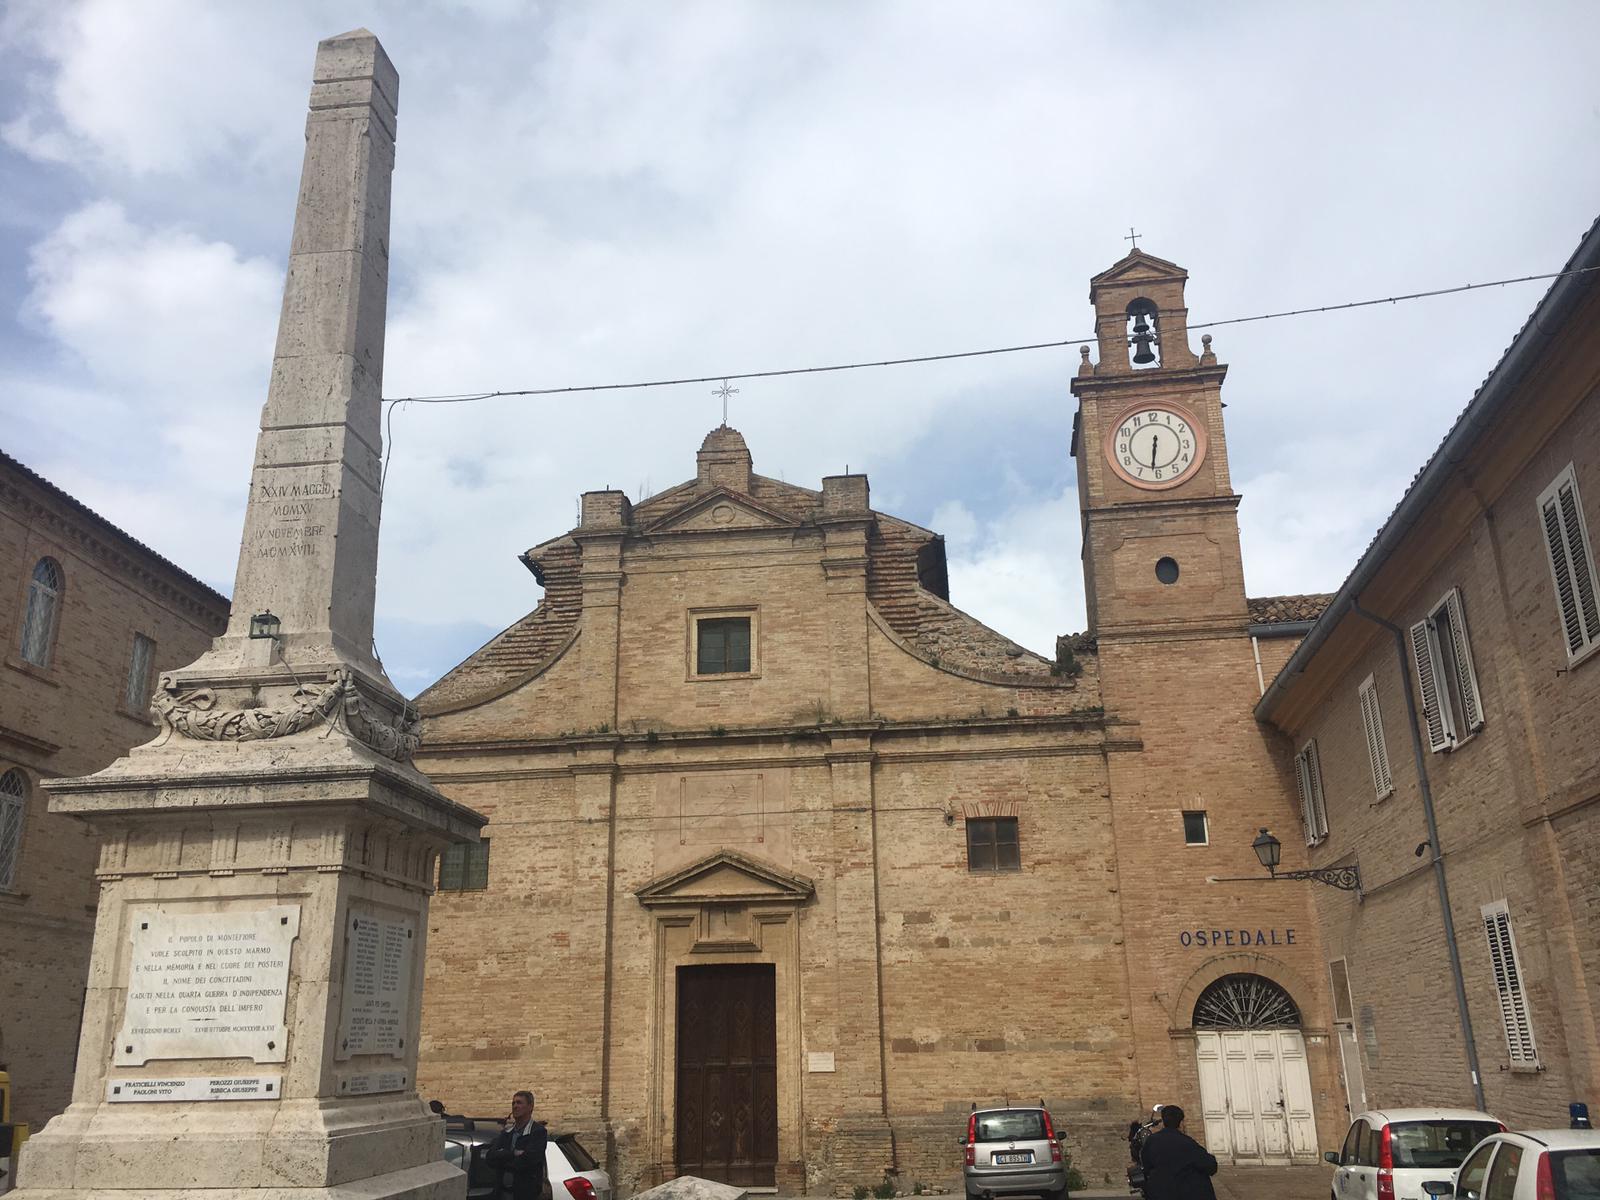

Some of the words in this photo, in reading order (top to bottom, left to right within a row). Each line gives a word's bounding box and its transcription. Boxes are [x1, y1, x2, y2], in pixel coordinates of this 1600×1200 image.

[1133, 416, 1141, 427] 11
[1148, 412, 1158, 422] 12
[1166, 415, 1171, 425] 1
[1120, 427, 1131, 437] 10
[1178, 423, 1185, 433] 2
[1120, 443, 1127, 453] 9
[1182, 439, 1190, 449] 3
[1124, 456, 1131, 466] 8
[1181, 453, 1188, 463] 4
[1136, 467, 1143, 477] 7
[1172, 464, 1179, 474] 5
[1155, 469, 1162, 480] 6
[261, 486, 289, 498] XXIV
[290, 482, 331, 497] MAGGIO
[218, 933, 256, 941] MONTEFIORE
[1180, 929, 1297, 947] OSPEDALE
[246, 946, 271, 954] MARMO
[166, 963, 194, 971] MEMORIA
[179, 990, 202, 998] QUARTA
[181, 1004, 216, 1013] CONQUISTA
